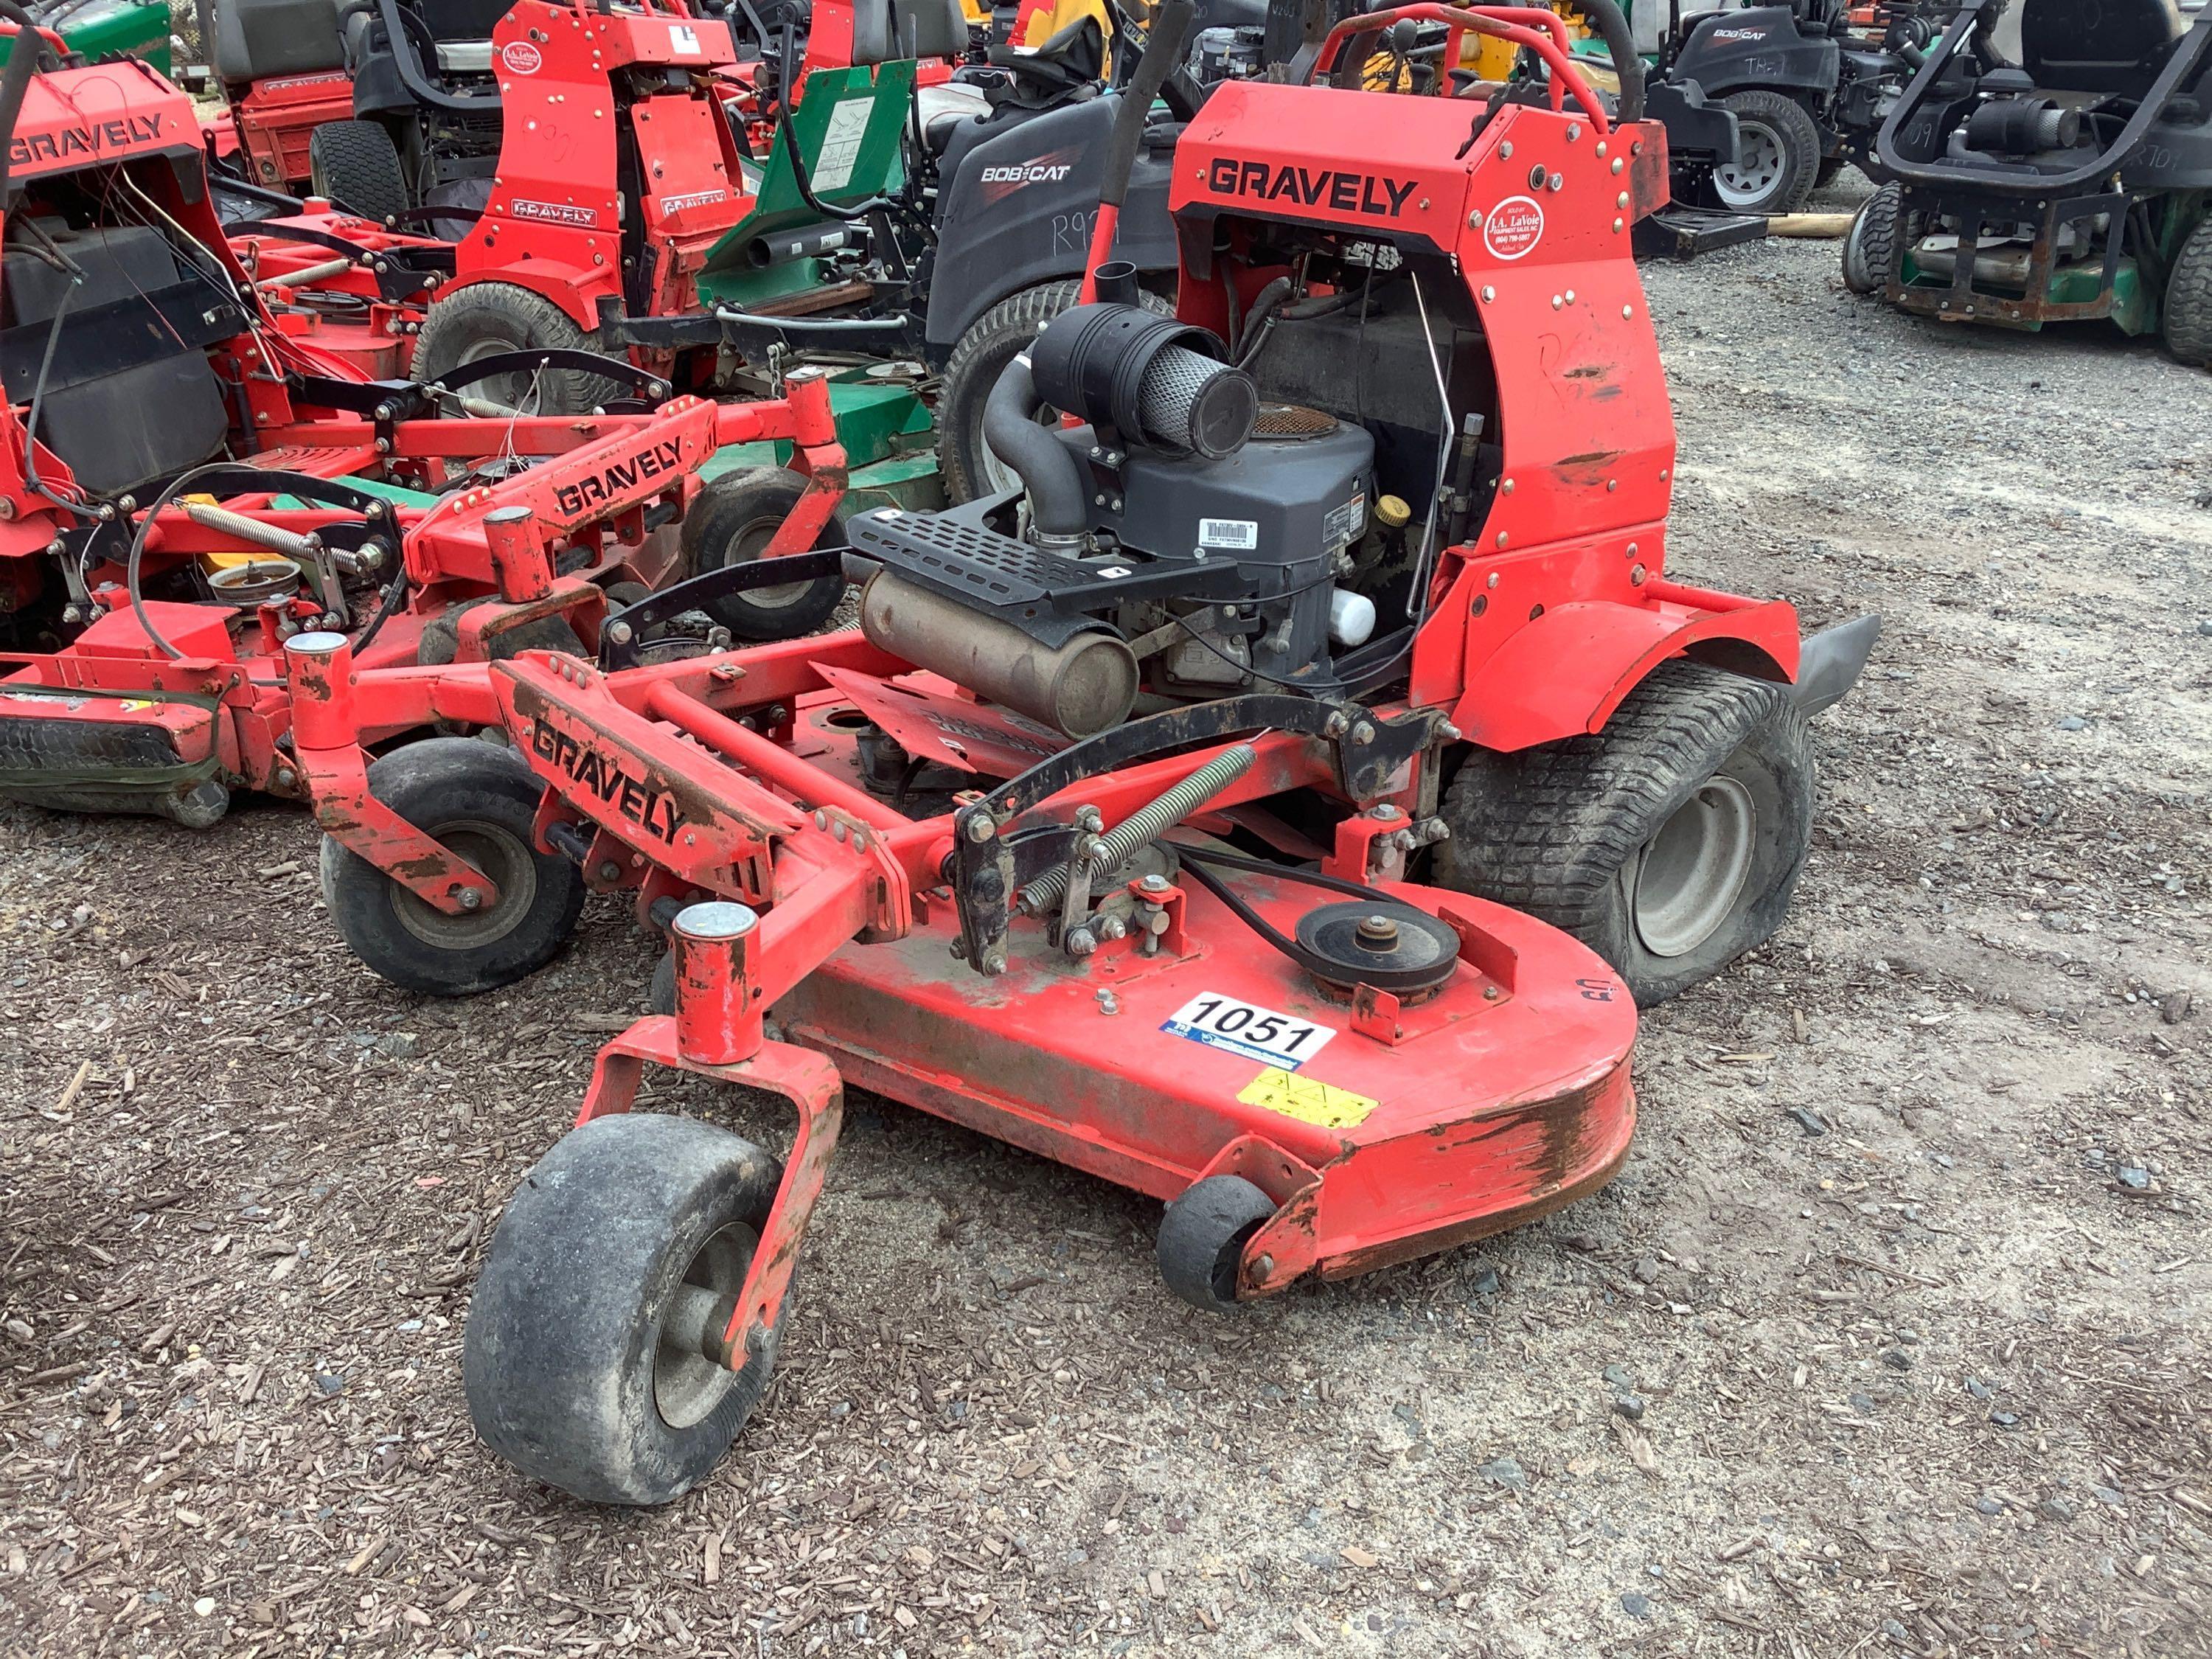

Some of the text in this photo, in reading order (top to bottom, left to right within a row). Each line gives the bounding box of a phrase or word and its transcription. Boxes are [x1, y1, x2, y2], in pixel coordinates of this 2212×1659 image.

[10, 113, 161, 166] GRAVELY
[513, 202, 594, 223] GRAVELY
[1209, 158, 1419, 218] GRAVELY
[1510, 213, 1540, 227] LaVoie
[557, 436, 682, 517] GRAVELY
[533, 718, 687, 846] GRAVELY
[1191, 1000, 1316, 1052] 1051
